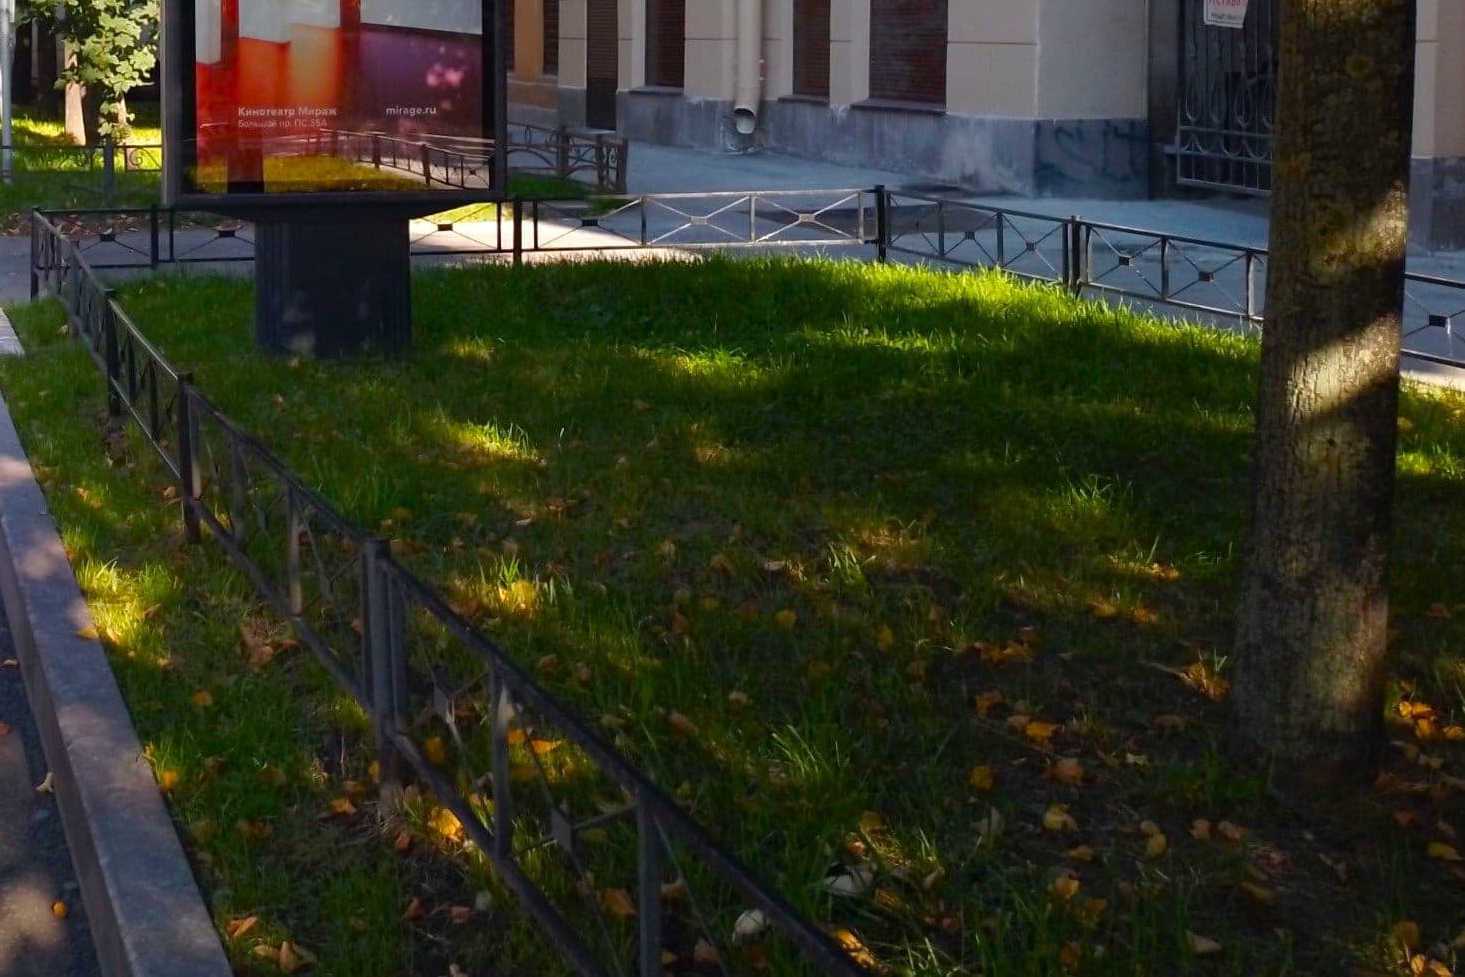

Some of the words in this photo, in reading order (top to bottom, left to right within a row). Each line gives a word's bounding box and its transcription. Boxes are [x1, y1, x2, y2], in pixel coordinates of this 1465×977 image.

[238, 106, 295, 117] Кинотеатр
[298, 106, 337, 117] Мираж
[385, 105, 437, 117] mirage.ru
